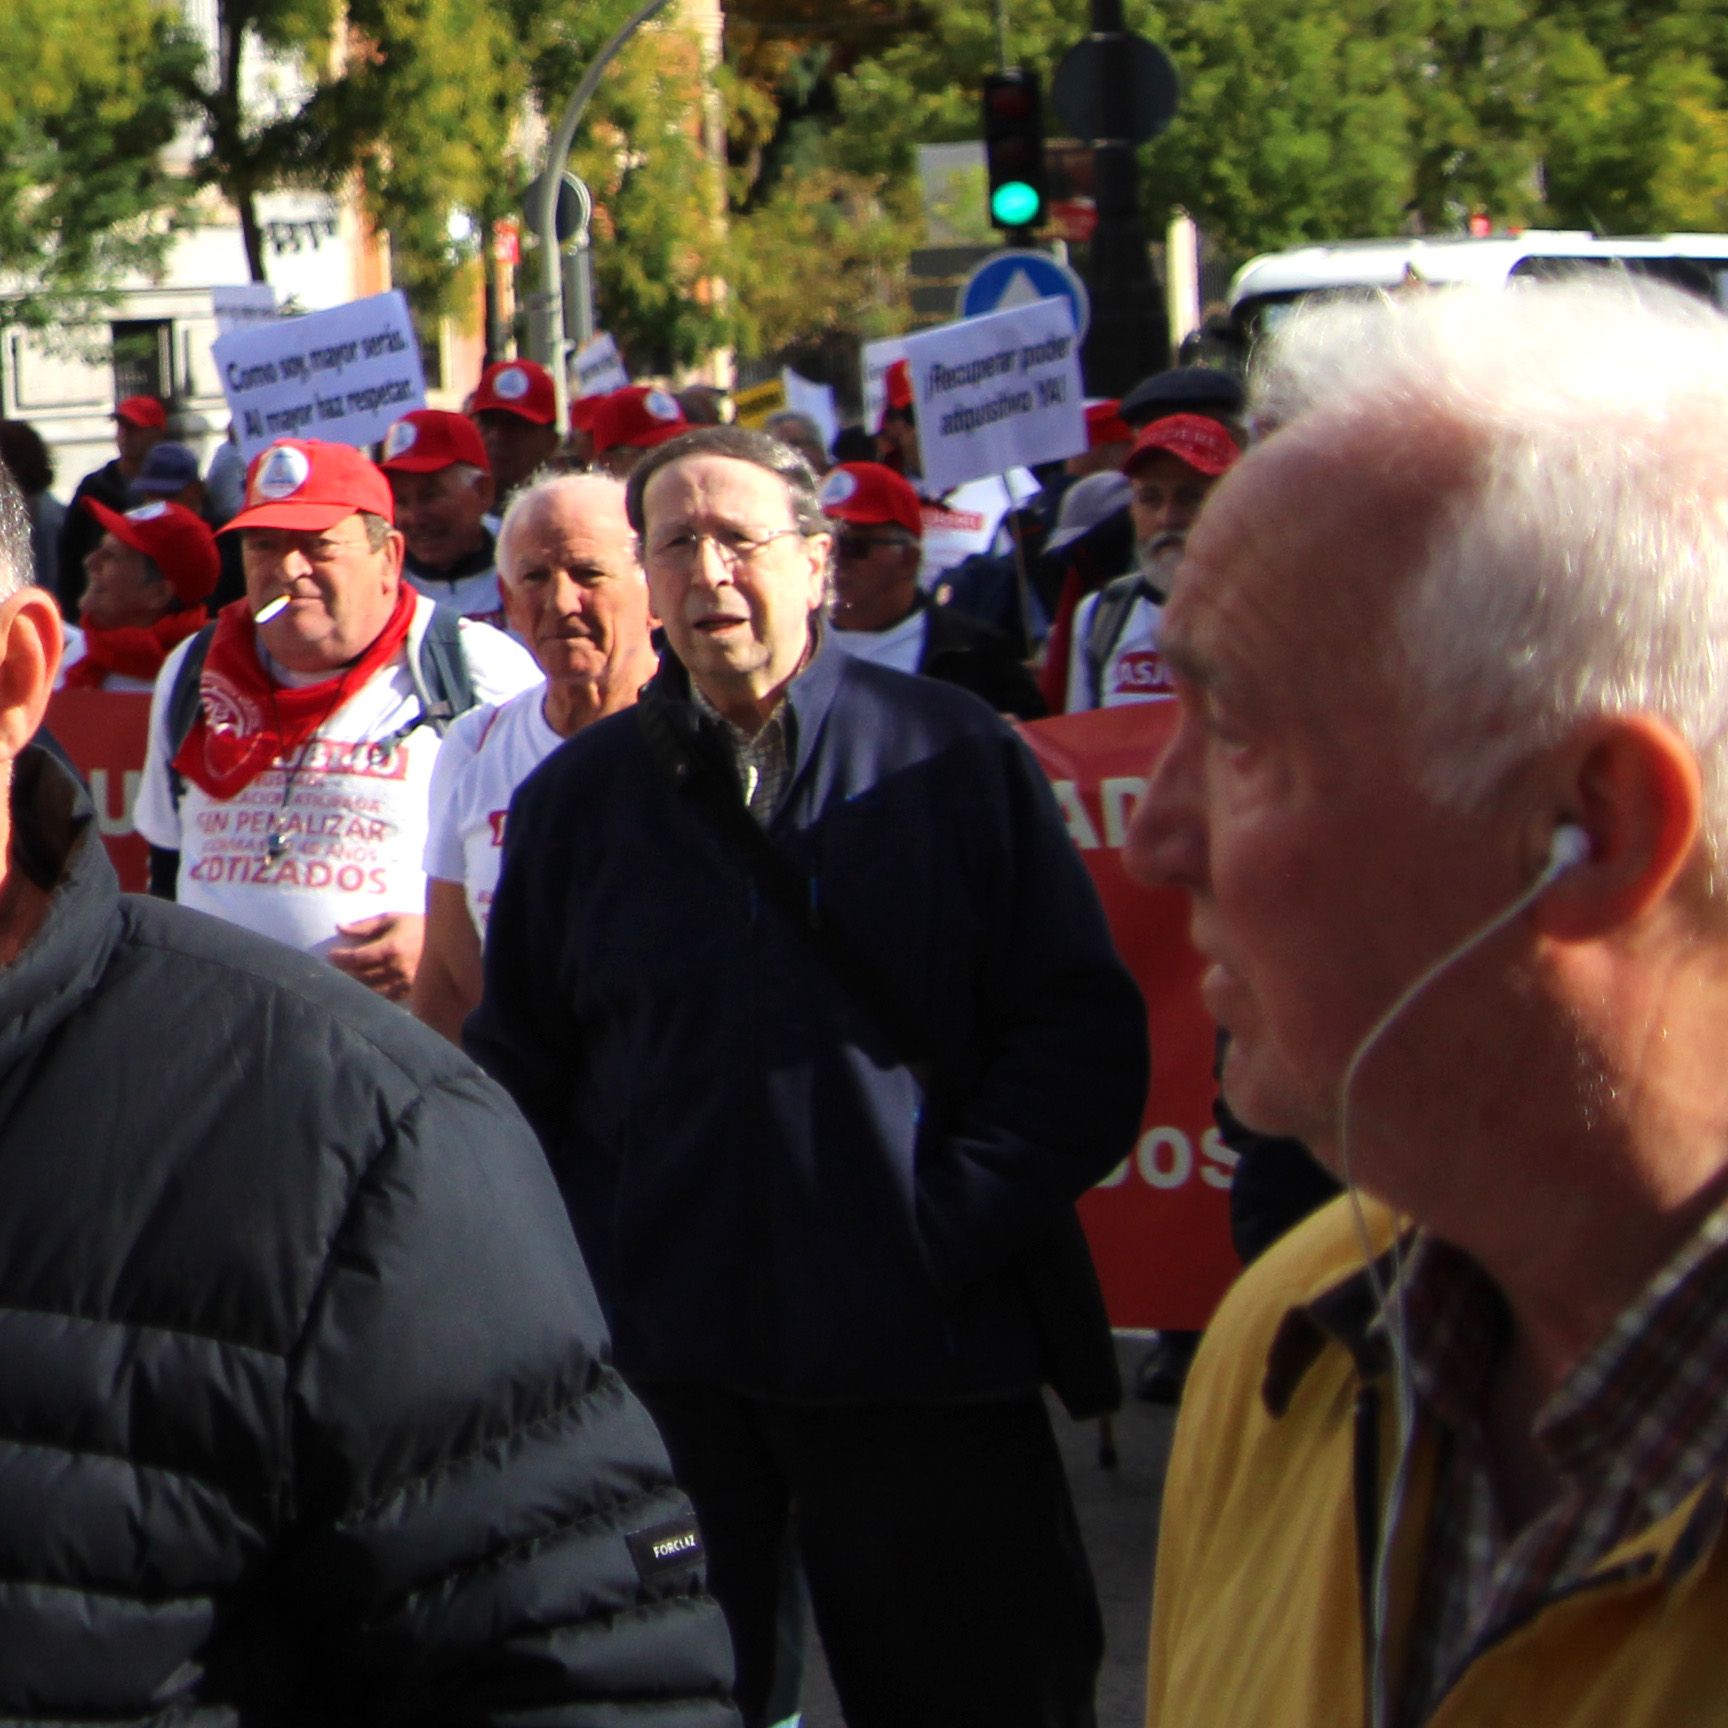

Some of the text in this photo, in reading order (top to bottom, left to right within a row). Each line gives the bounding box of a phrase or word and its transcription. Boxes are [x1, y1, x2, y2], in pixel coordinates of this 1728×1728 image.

[225, 361, 278, 393] Como
[308, 340, 359, 376] mayor
[1019, 332, 1072, 373] poder
[265, 403, 314, 436] mayor
[189, 856, 388, 896] COTIZADOS
[652, 1534, 696, 1559] FORCLAZ
